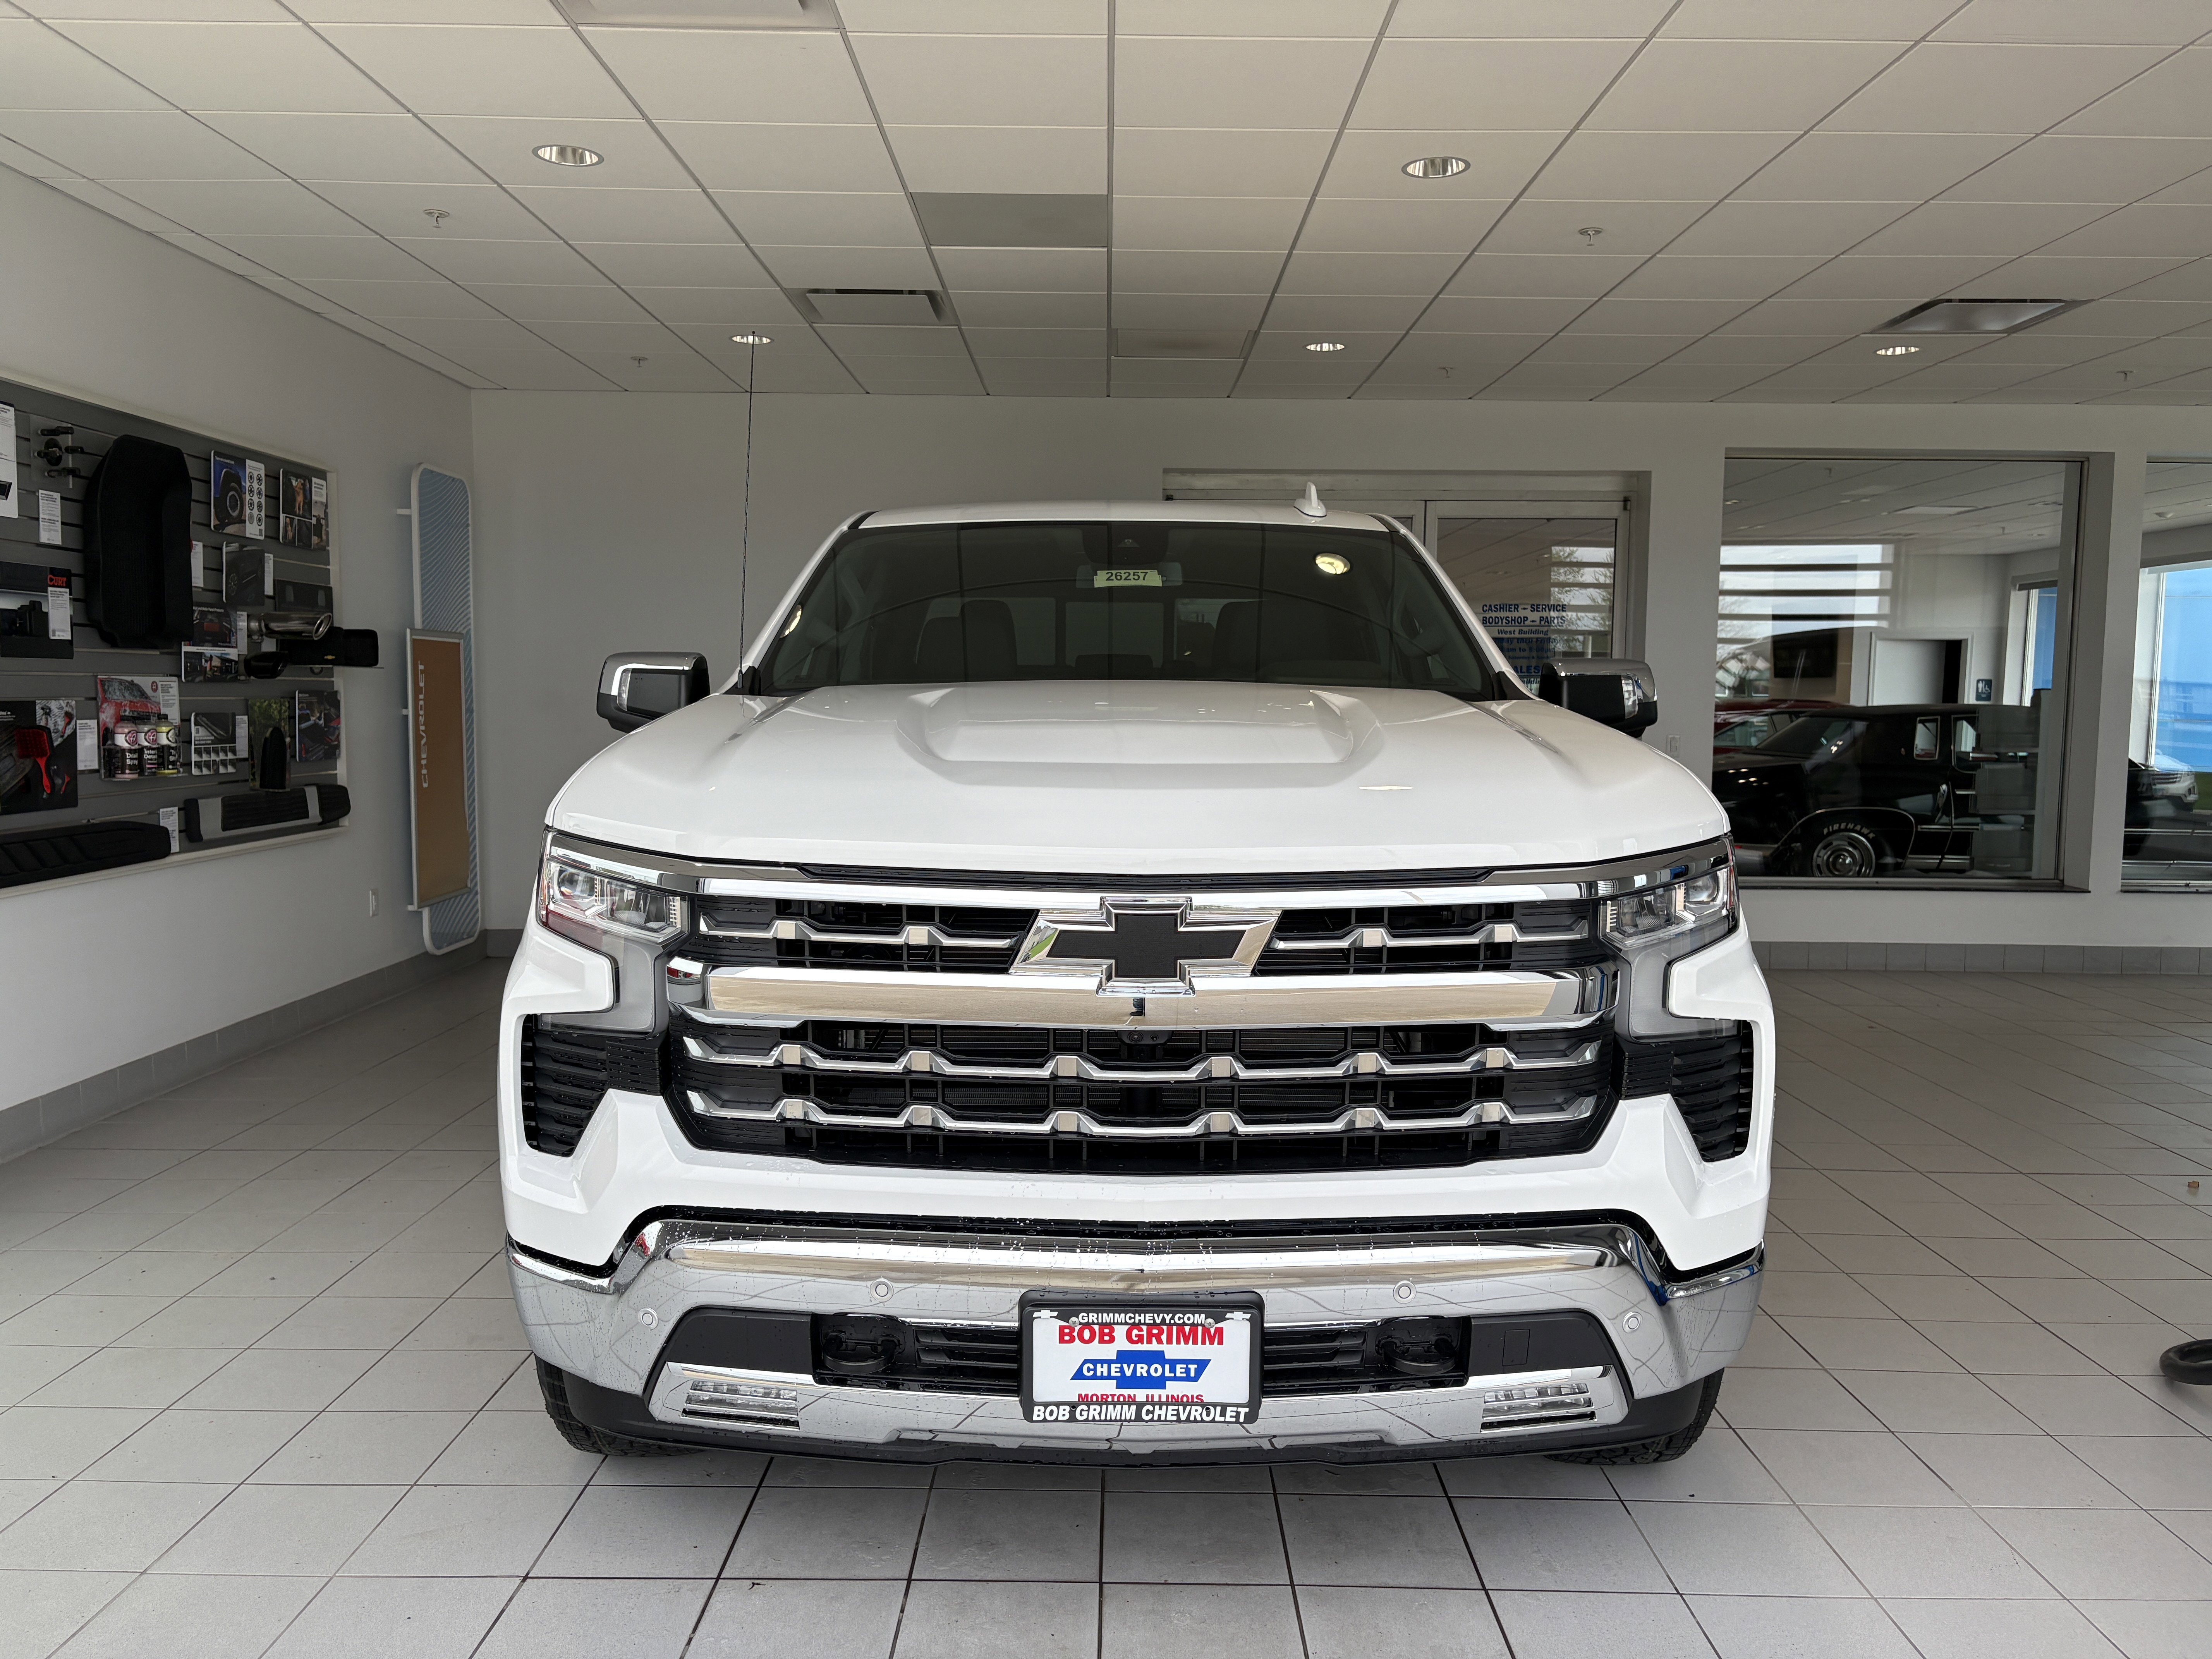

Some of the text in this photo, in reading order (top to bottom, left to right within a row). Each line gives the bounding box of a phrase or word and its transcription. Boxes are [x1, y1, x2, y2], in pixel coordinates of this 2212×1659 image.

[48, 574, 66, 586] CURT
[1106, 572, 1148, 581] 26257
[1482, 604, 1566, 612] CASHIER SERVICE
[1482, 616, 1566, 625] BODYSHOP PARTS
[419, 660, 428, 788] CHEVROLET
[1823, 823, 1875, 839] FIREHAWK
[1079, 1313, 1205, 1324] GRIMMCHEVY.COM
[1058, 1325, 1223, 1346] BOB GRIMM
[1083, 1363, 1197, 1377] CHEVROLET
[1078, 1393, 1136, 1401] MORTON
[1033, 1405, 1249, 1422] BOB GRIMM CHEVROLET
